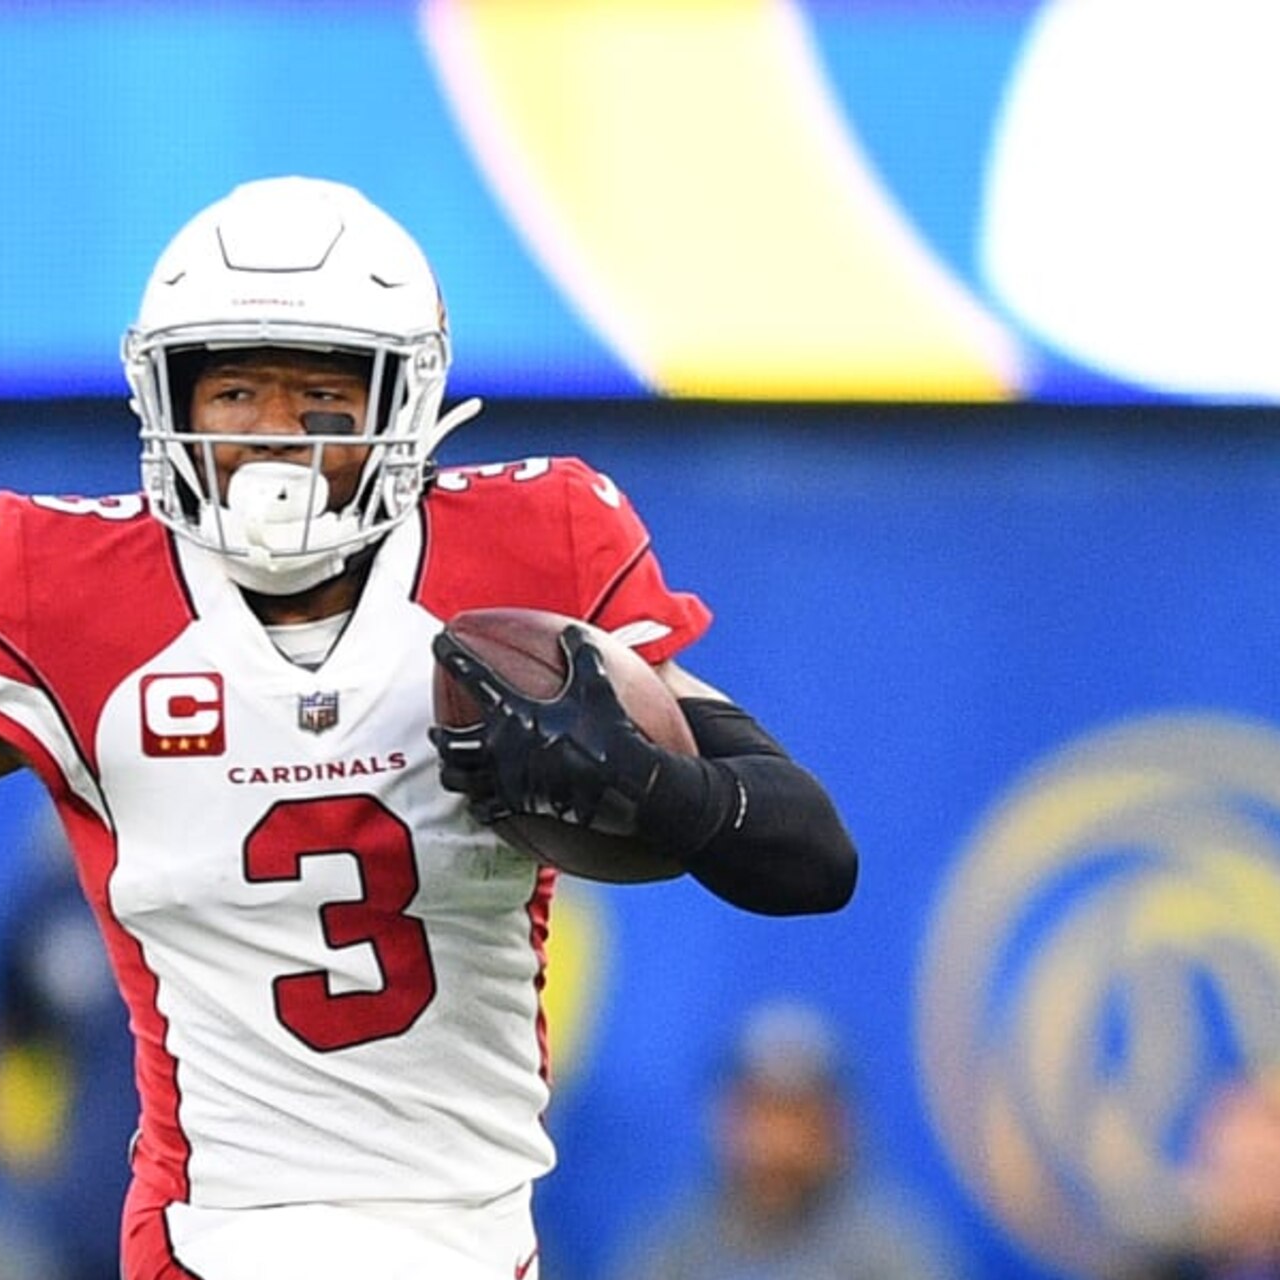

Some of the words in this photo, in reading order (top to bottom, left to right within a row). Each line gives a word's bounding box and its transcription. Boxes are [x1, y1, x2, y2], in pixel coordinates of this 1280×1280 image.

[145, 676, 220, 735] C
[227, 752, 408, 785] CARDINALS
[243, 793, 437, 1053] 3
